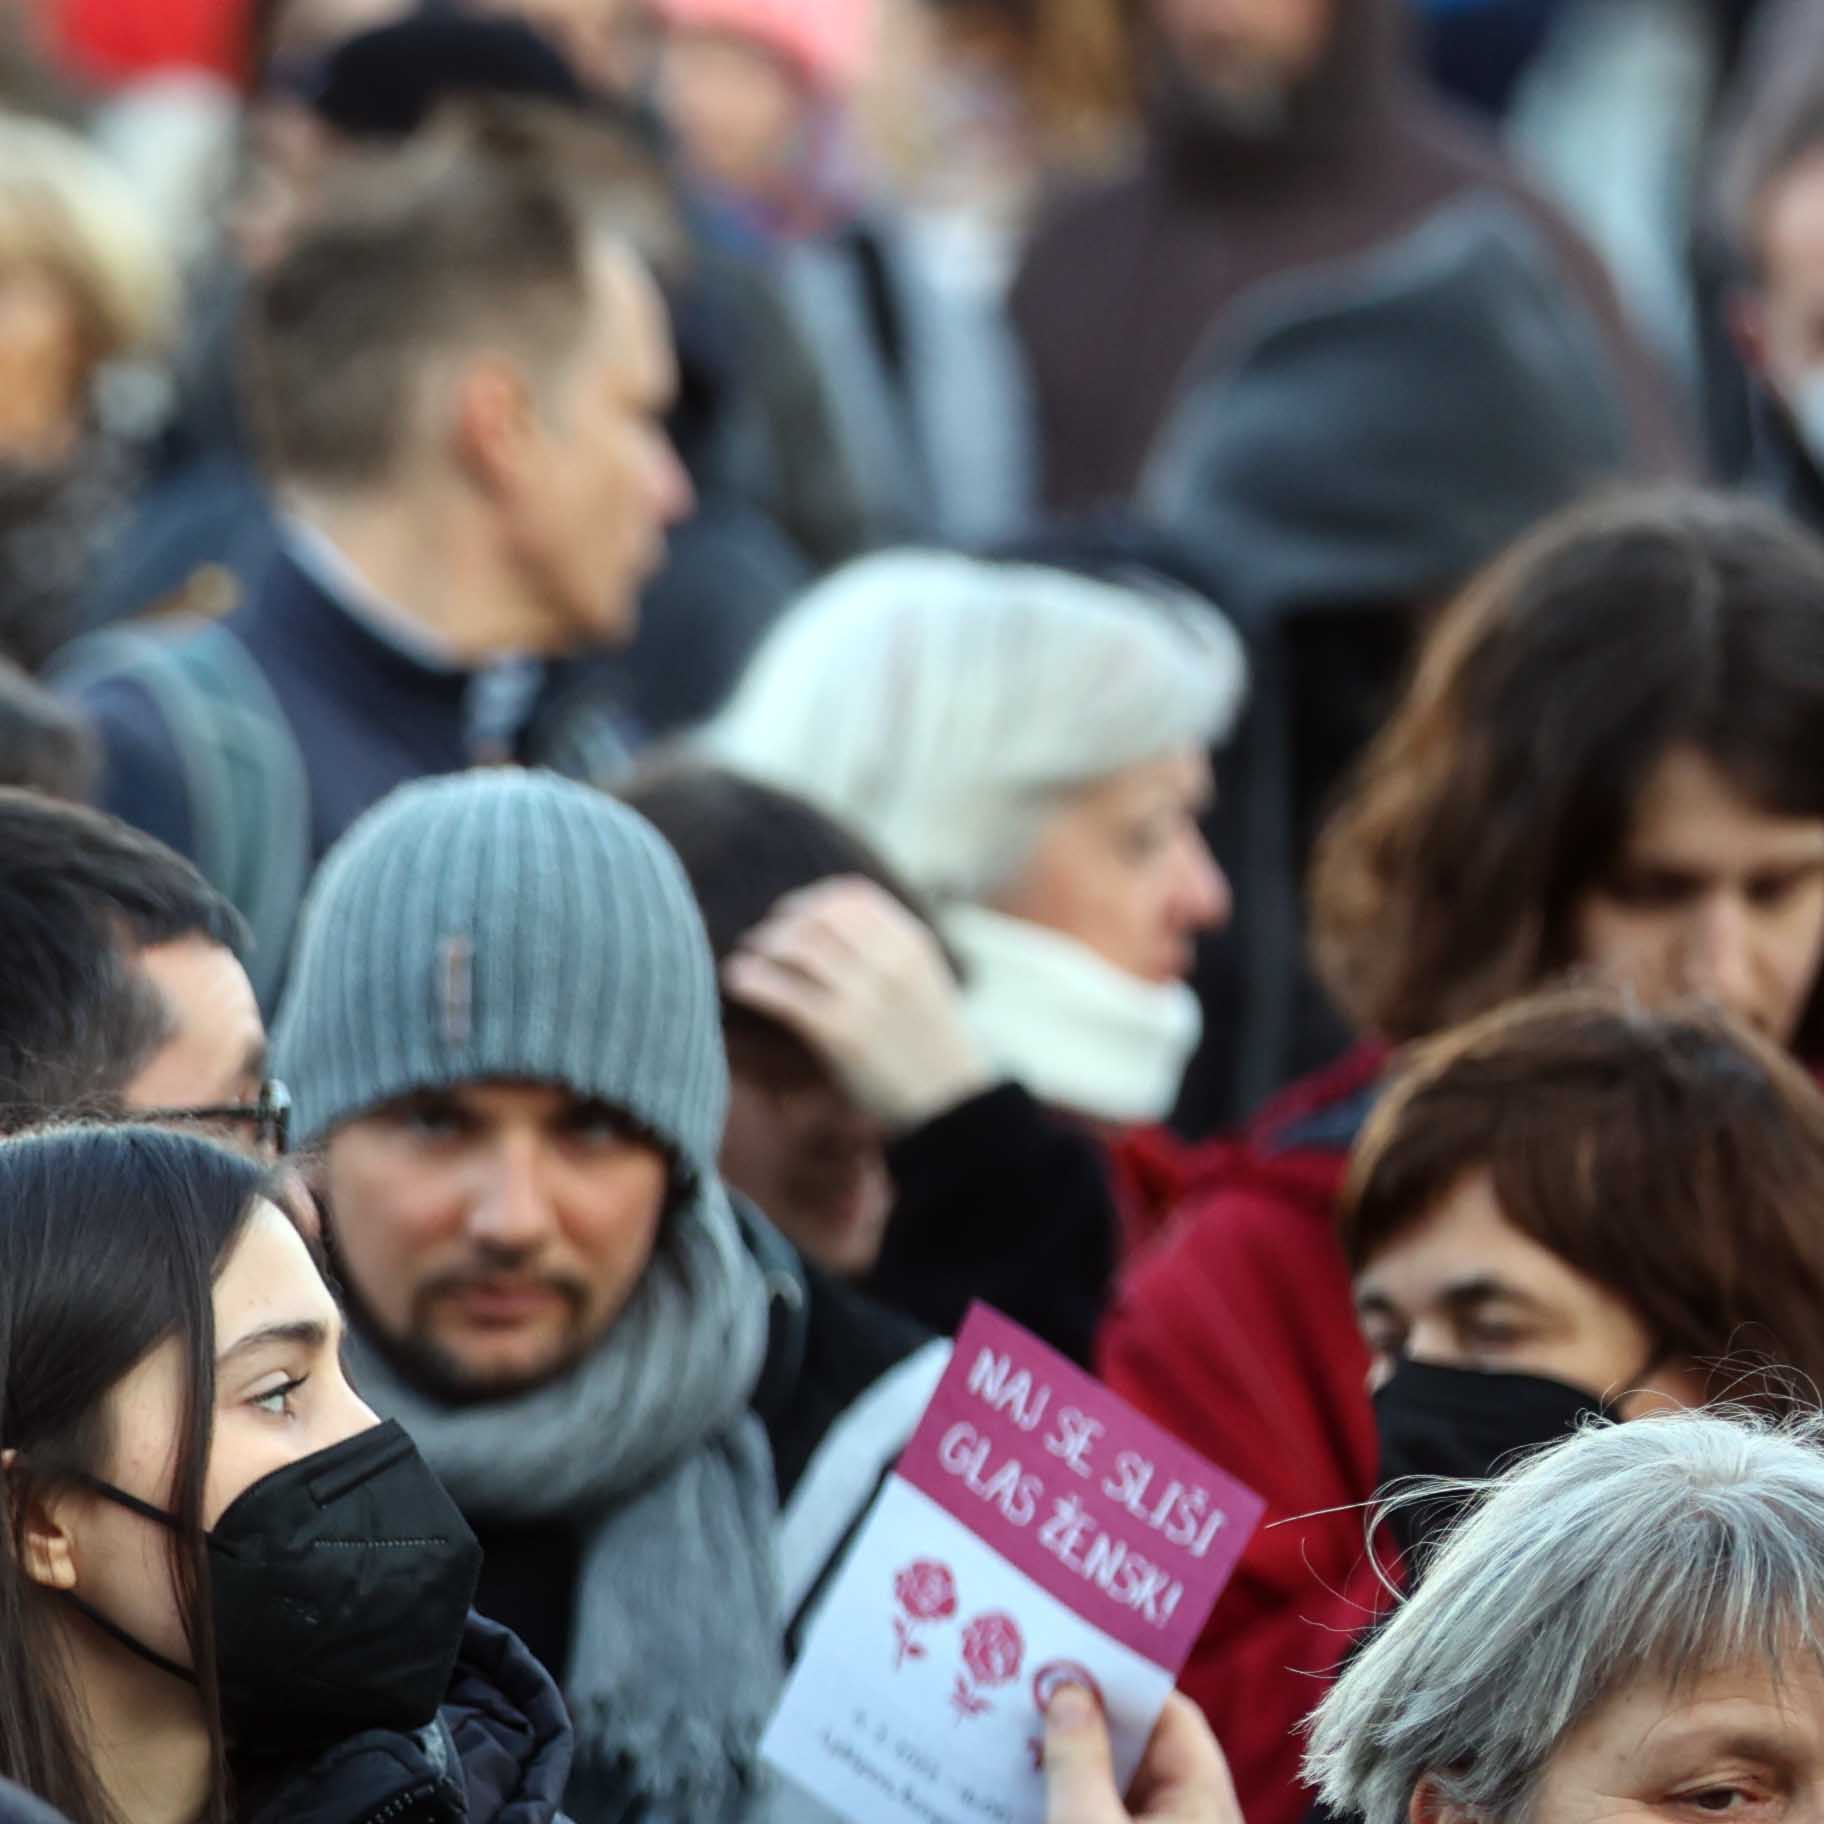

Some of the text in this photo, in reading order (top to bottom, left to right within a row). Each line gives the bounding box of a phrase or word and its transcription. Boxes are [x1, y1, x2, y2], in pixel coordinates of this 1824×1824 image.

[939, 1421, 1044, 1527] GLAS
[967, 1347, 1228, 1558] NAJ SE SLIŠI
